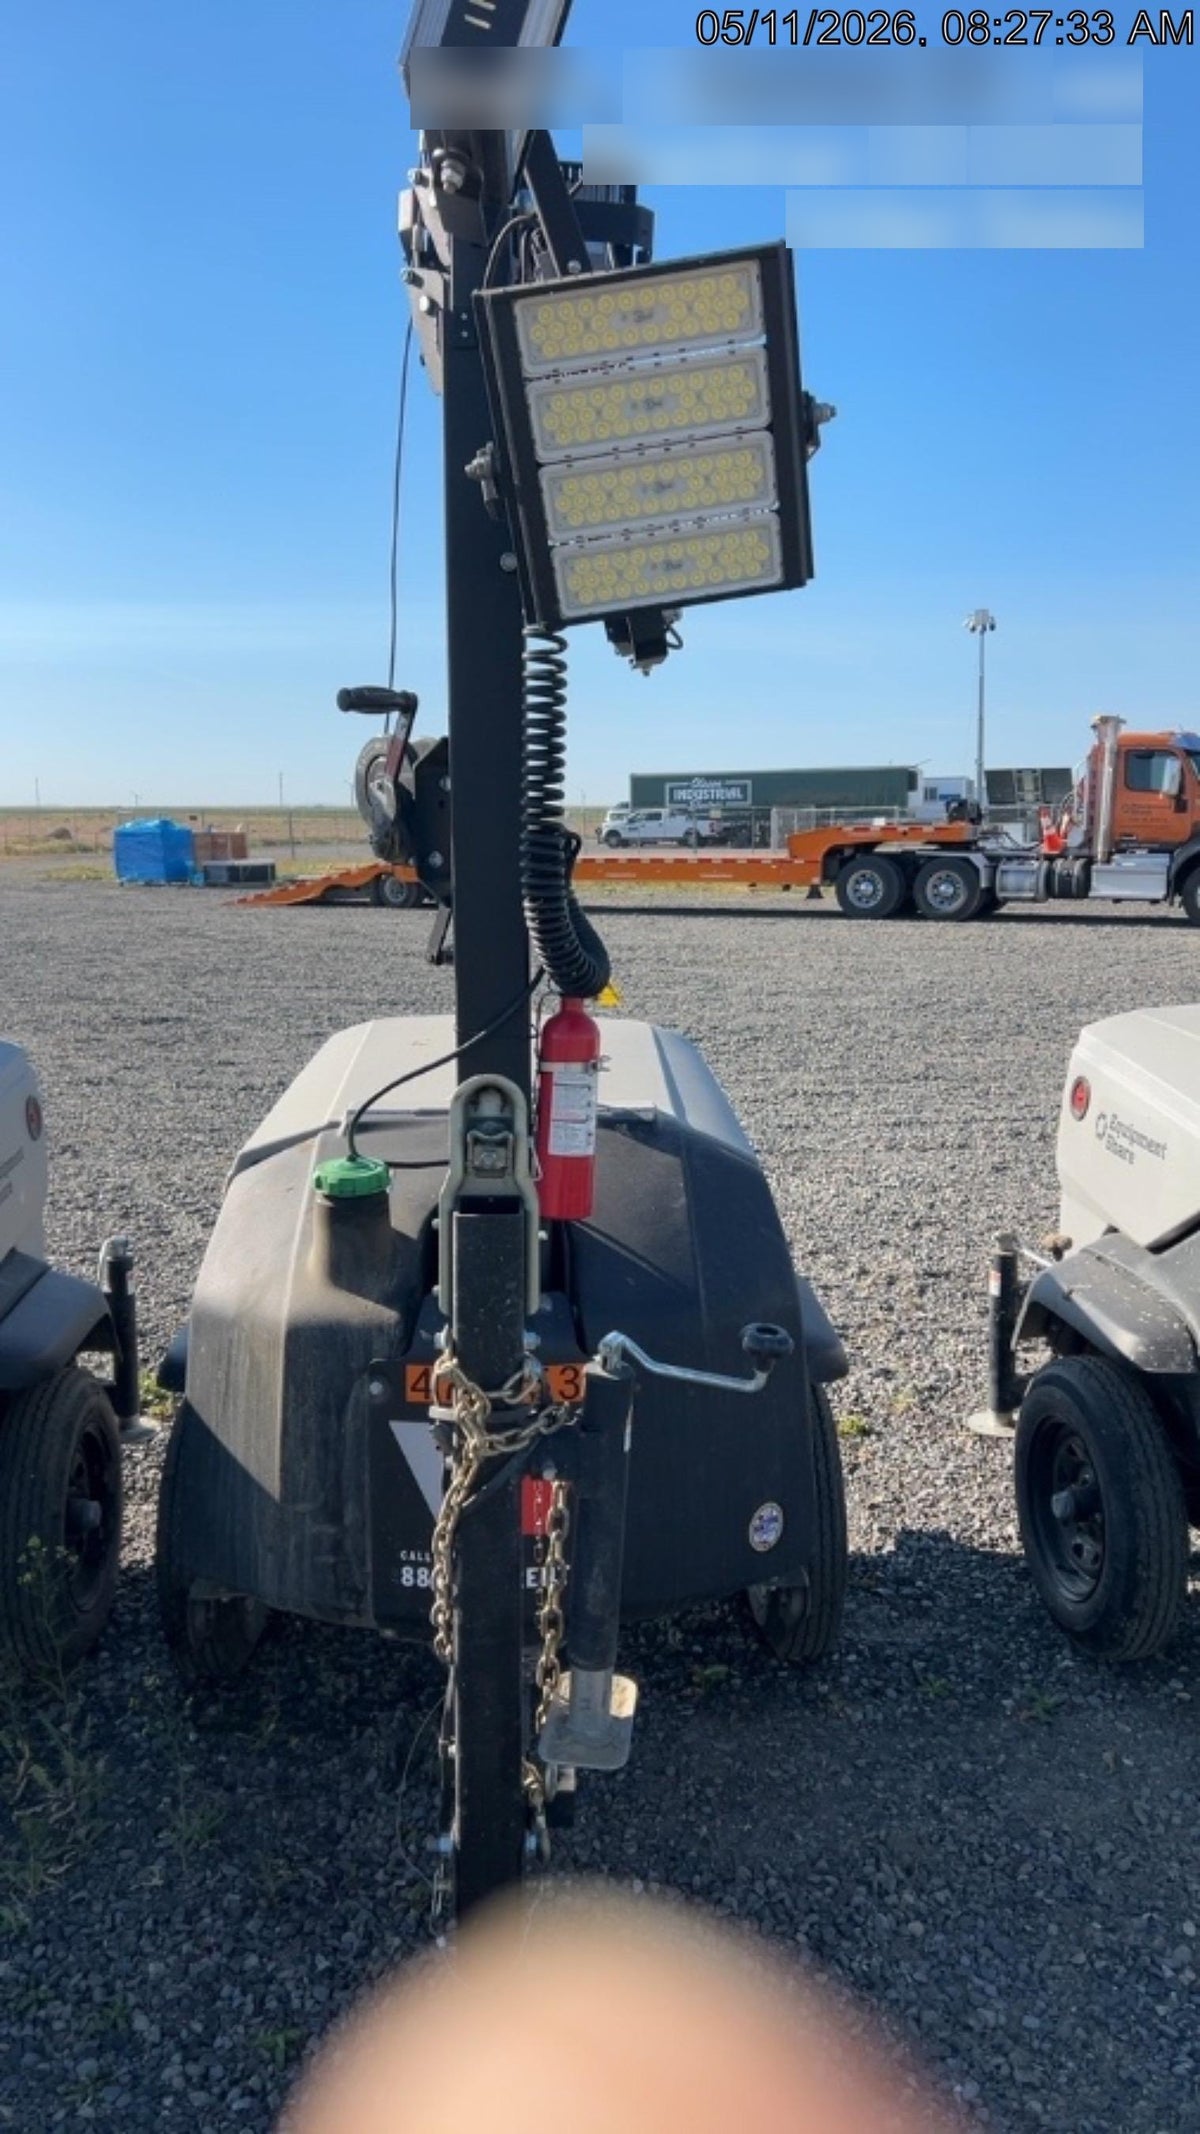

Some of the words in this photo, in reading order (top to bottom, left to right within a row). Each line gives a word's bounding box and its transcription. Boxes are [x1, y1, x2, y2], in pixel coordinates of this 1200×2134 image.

[672, 787, 744, 801] INDUSTRIAL
[1104, 1132, 1135, 1165] Share
[1108, 1112, 1168, 1161] Equipment
